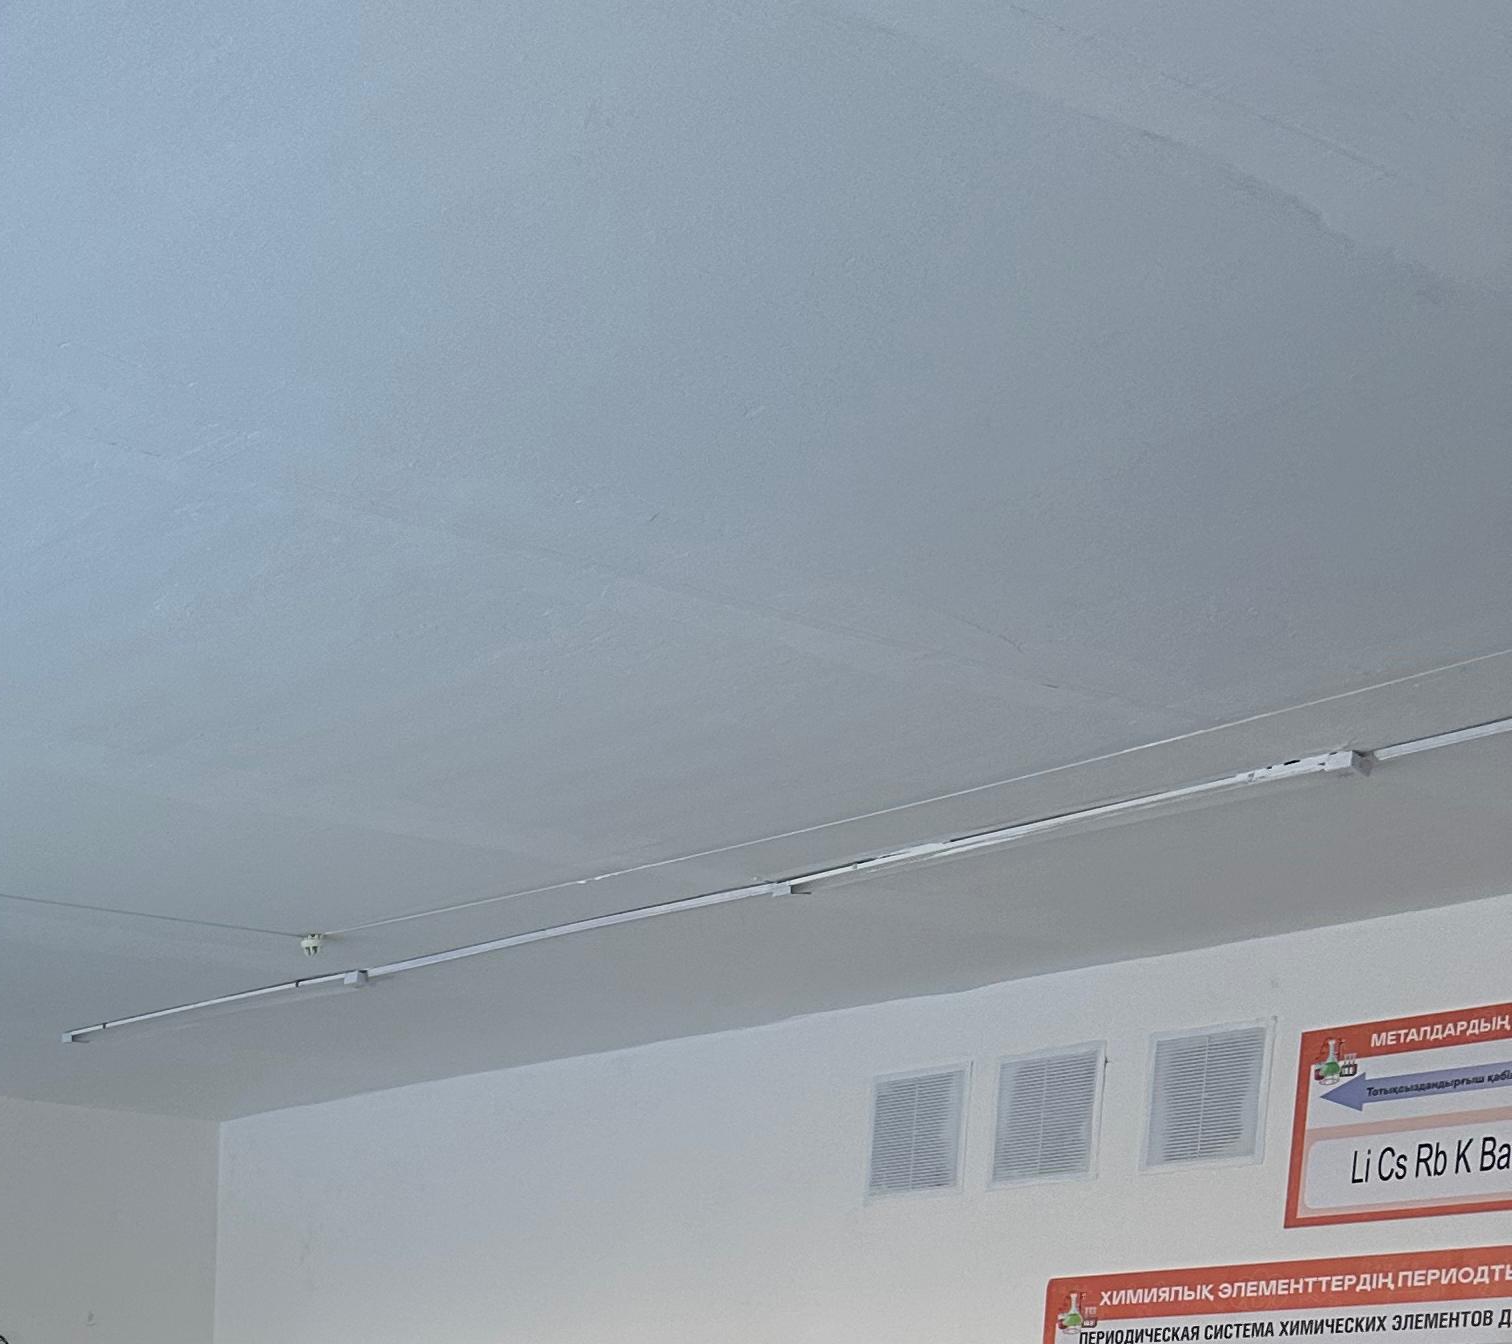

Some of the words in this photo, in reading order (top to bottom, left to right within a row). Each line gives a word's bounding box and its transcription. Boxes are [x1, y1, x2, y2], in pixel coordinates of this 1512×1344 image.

[1370, 1015, 1510, 1048] МЕТАЛДАРДЫҢ
[1351, 1149, 1372, 1184] Li
[1378, 1146, 1408, 1181] Cs
[1415, 1142, 1447, 1178] Rb
[1454, 1138, 1474, 1174] K
[1479, 1136, 1511, 1172] Ba
[1099, 1284, 1214, 1307] ХИМИЯЛЫҚ
[1218, 1272, 1395, 1299] ЭЛЕМЕНТТЕРДІҢ
[1204, 1320, 1274, 1341] СИСТЕМА
[1279, 1314, 1387, 1338] ХИМИЧЕСКИХ
[1391, 1309, 1493, 1331] ЭЛЕМЕНТОВ
